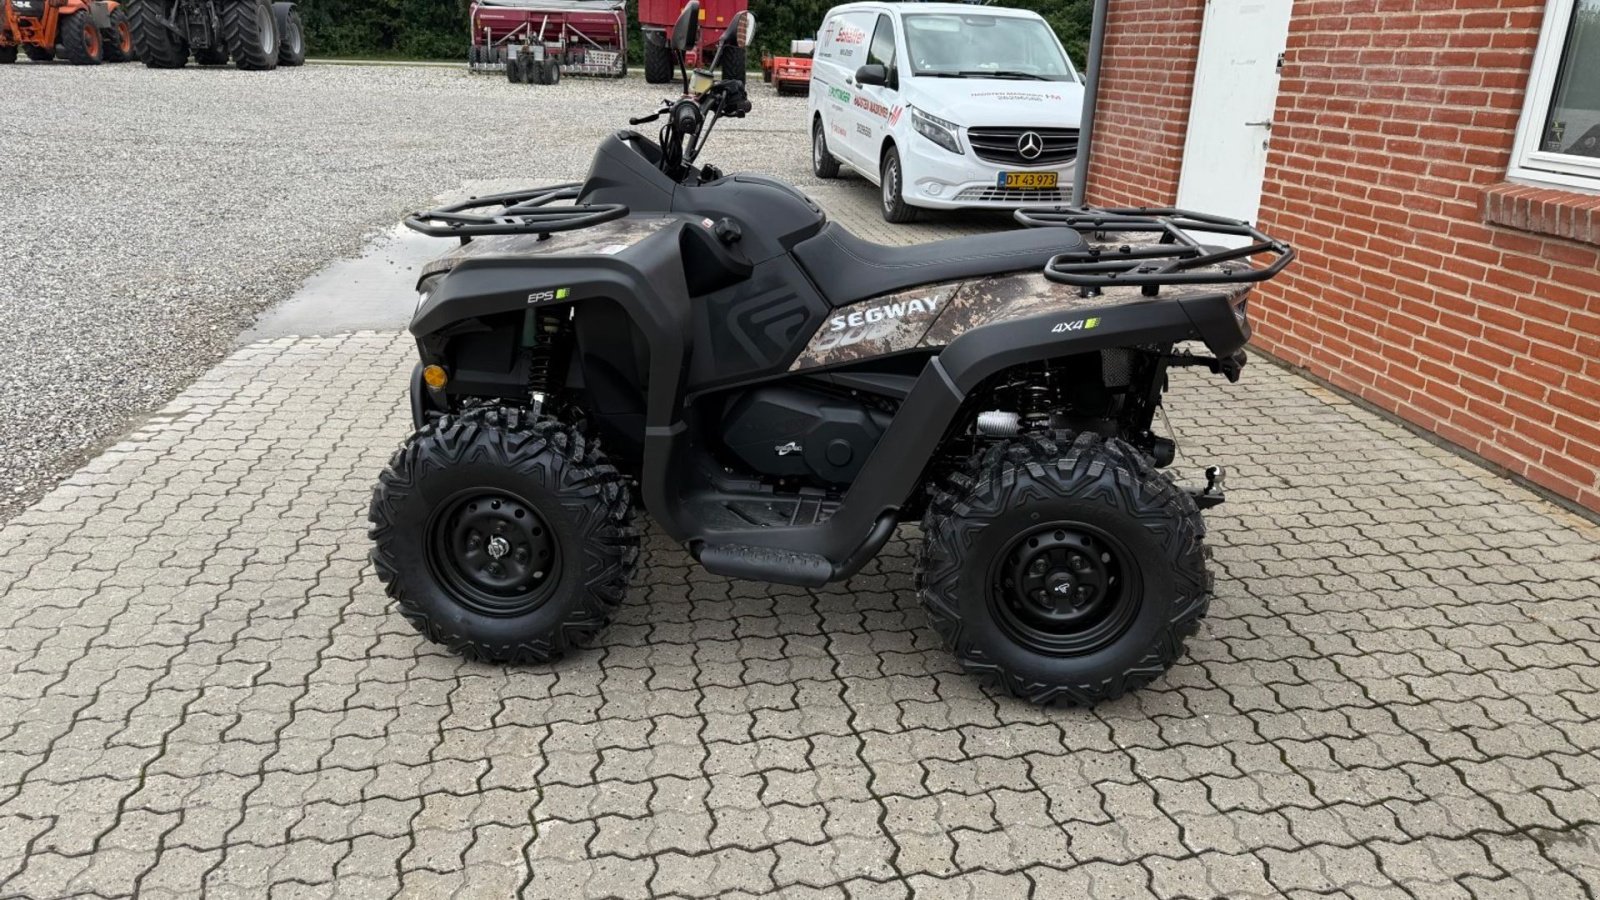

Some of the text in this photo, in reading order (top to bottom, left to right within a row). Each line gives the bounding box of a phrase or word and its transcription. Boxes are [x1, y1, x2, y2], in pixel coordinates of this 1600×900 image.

[1006, 174, 1055, 186] DT 43 973
[527, 290, 554, 304] EPS
[830, 295, 940, 331] SEGWAY
